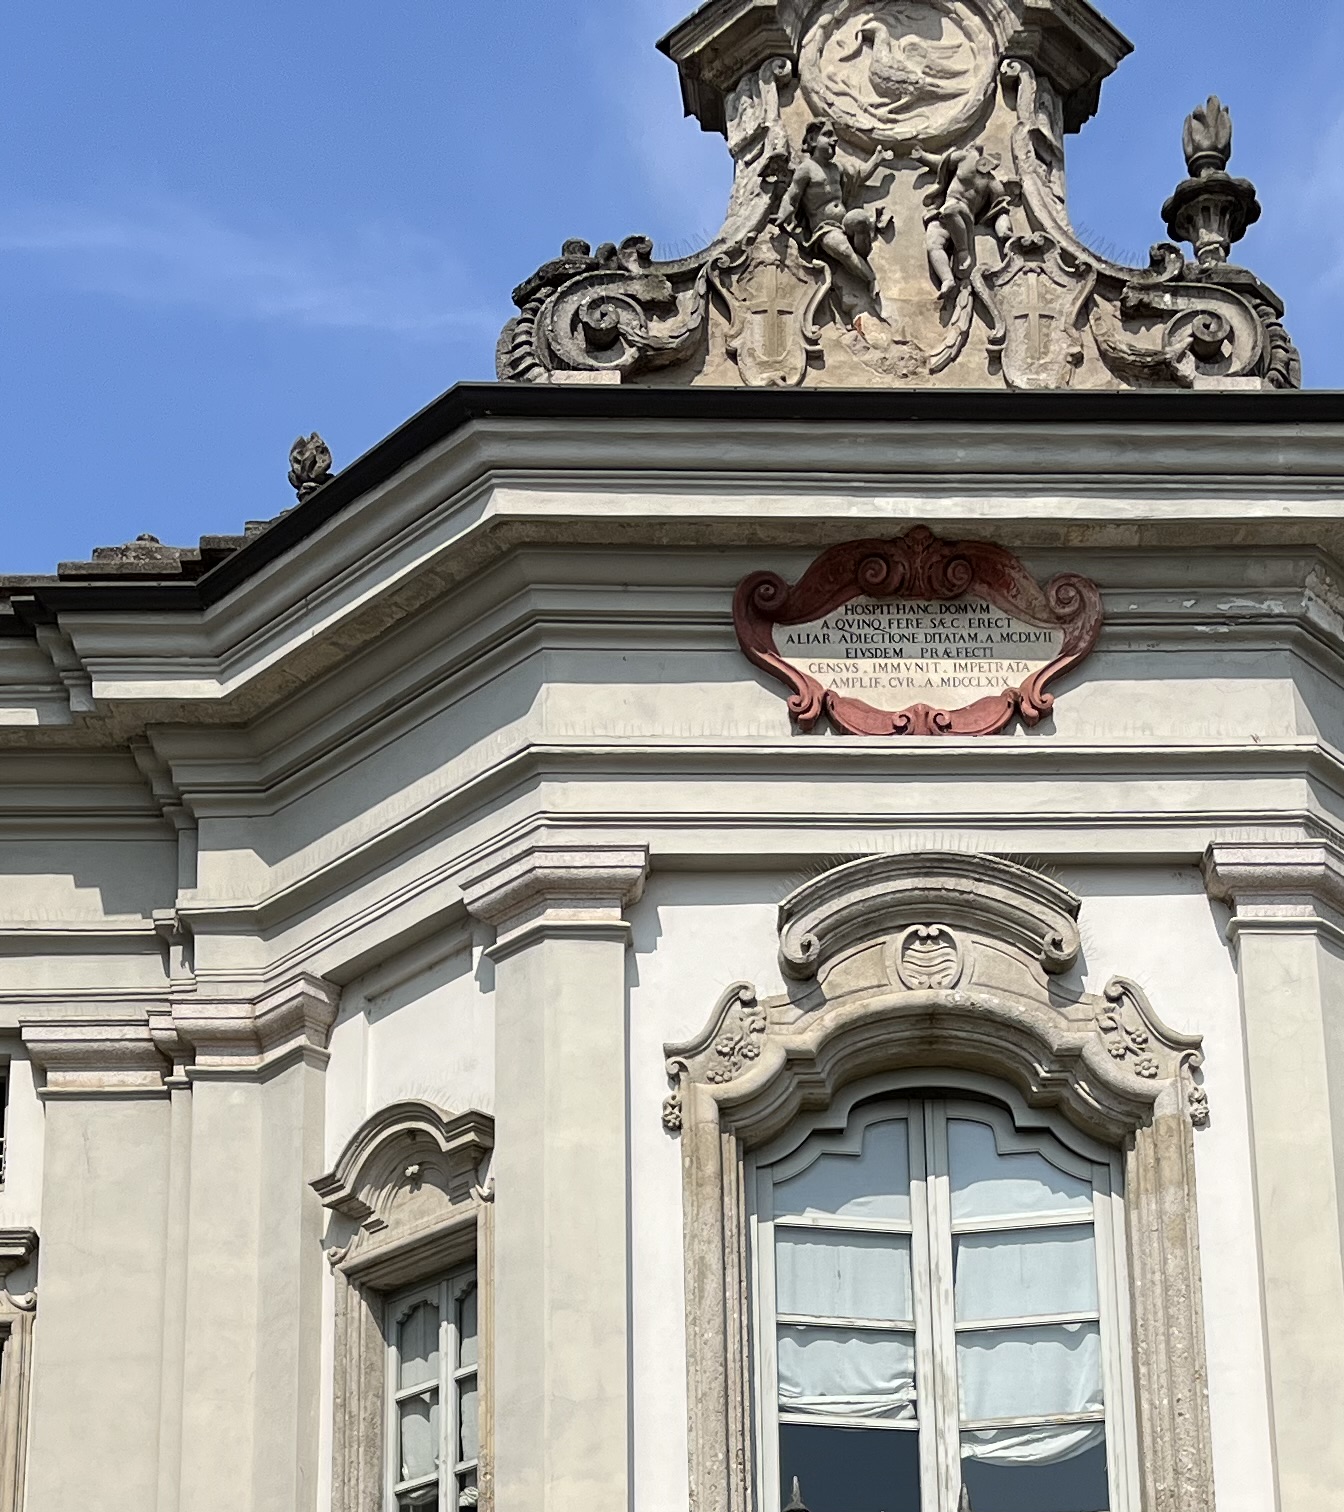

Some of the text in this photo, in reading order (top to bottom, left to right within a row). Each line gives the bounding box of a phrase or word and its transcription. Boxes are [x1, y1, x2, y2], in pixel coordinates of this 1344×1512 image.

[939, 603, 990, 614] DOMVM
[968, 618, 1013, 628] ERECT
[1000, 632, 1052, 643] MCDLVII
[953, 661, 1031, 673] IMPETRATA
[940, 676, 1010, 688] MDCCLXIX
